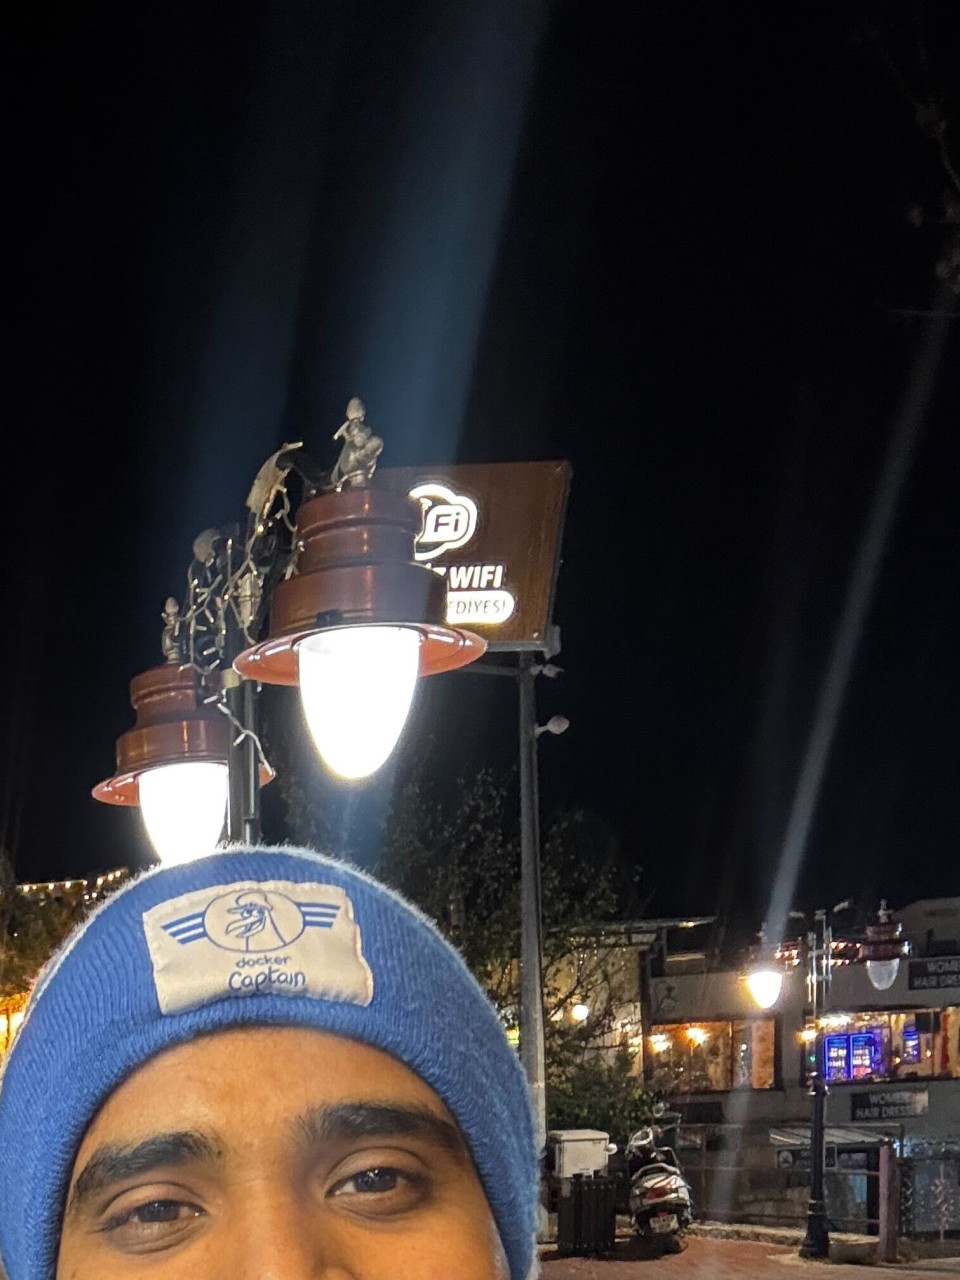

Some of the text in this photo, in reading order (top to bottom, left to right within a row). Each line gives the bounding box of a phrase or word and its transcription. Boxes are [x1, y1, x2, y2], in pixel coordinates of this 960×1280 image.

[449, 565, 503, 589] WIFI
[236, 954, 291, 968] docker
[228, 965, 307, 992] Captain
